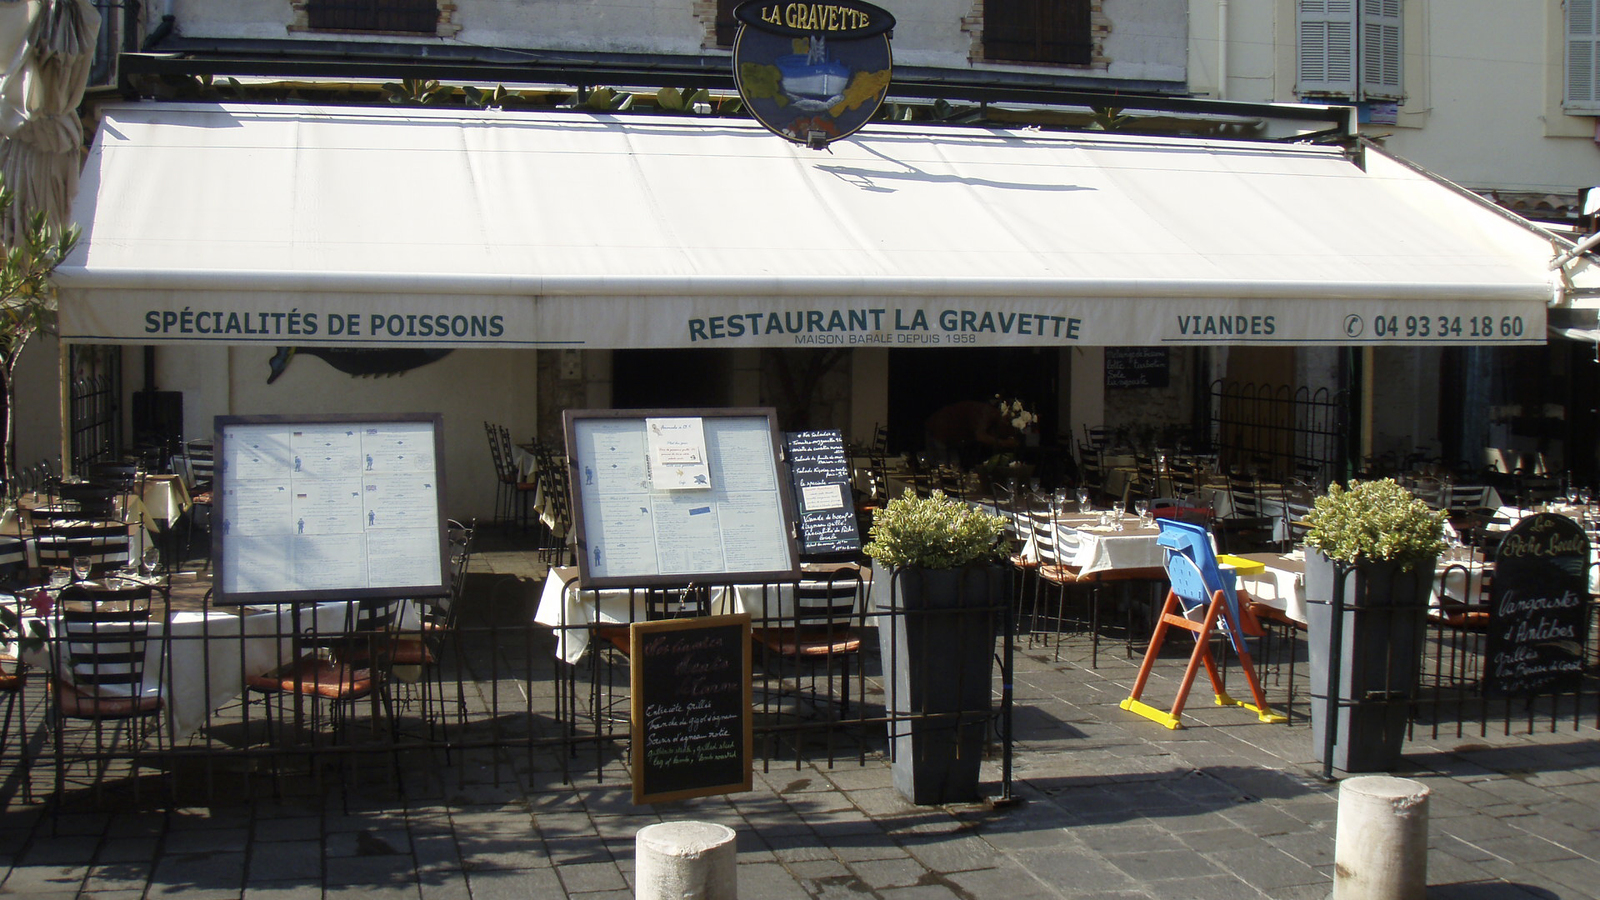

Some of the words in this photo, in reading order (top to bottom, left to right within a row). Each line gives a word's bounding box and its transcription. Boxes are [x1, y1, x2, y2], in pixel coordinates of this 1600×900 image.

[761, 5, 782, 25] LA
[785, 3, 870, 31] GRAVETTE
[144, 306, 319, 335] SPÉCIALITÉS
[328, 314, 361, 336] DE
[370, 314, 505, 337] POISSONS
[688, 309, 886, 342] RESTAURANT
[895, 309, 929, 331] LA
[939, 309, 1082, 340] GRAVETTE
[1177, 315, 1276, 335] VIANDES
[1374, 316, 1399, 336] 04
[1406, 316, 1431, 337] 93
[1438, 316, 1463, 337] 34
[1470, 316, 1493, 337] 18
[1500, 316, 1524, 336] 60
[794, 334, 844, 344] MAISON
[897, 334, 941, 344] DEPUIS
[945, 334, 977, 344] 1958
